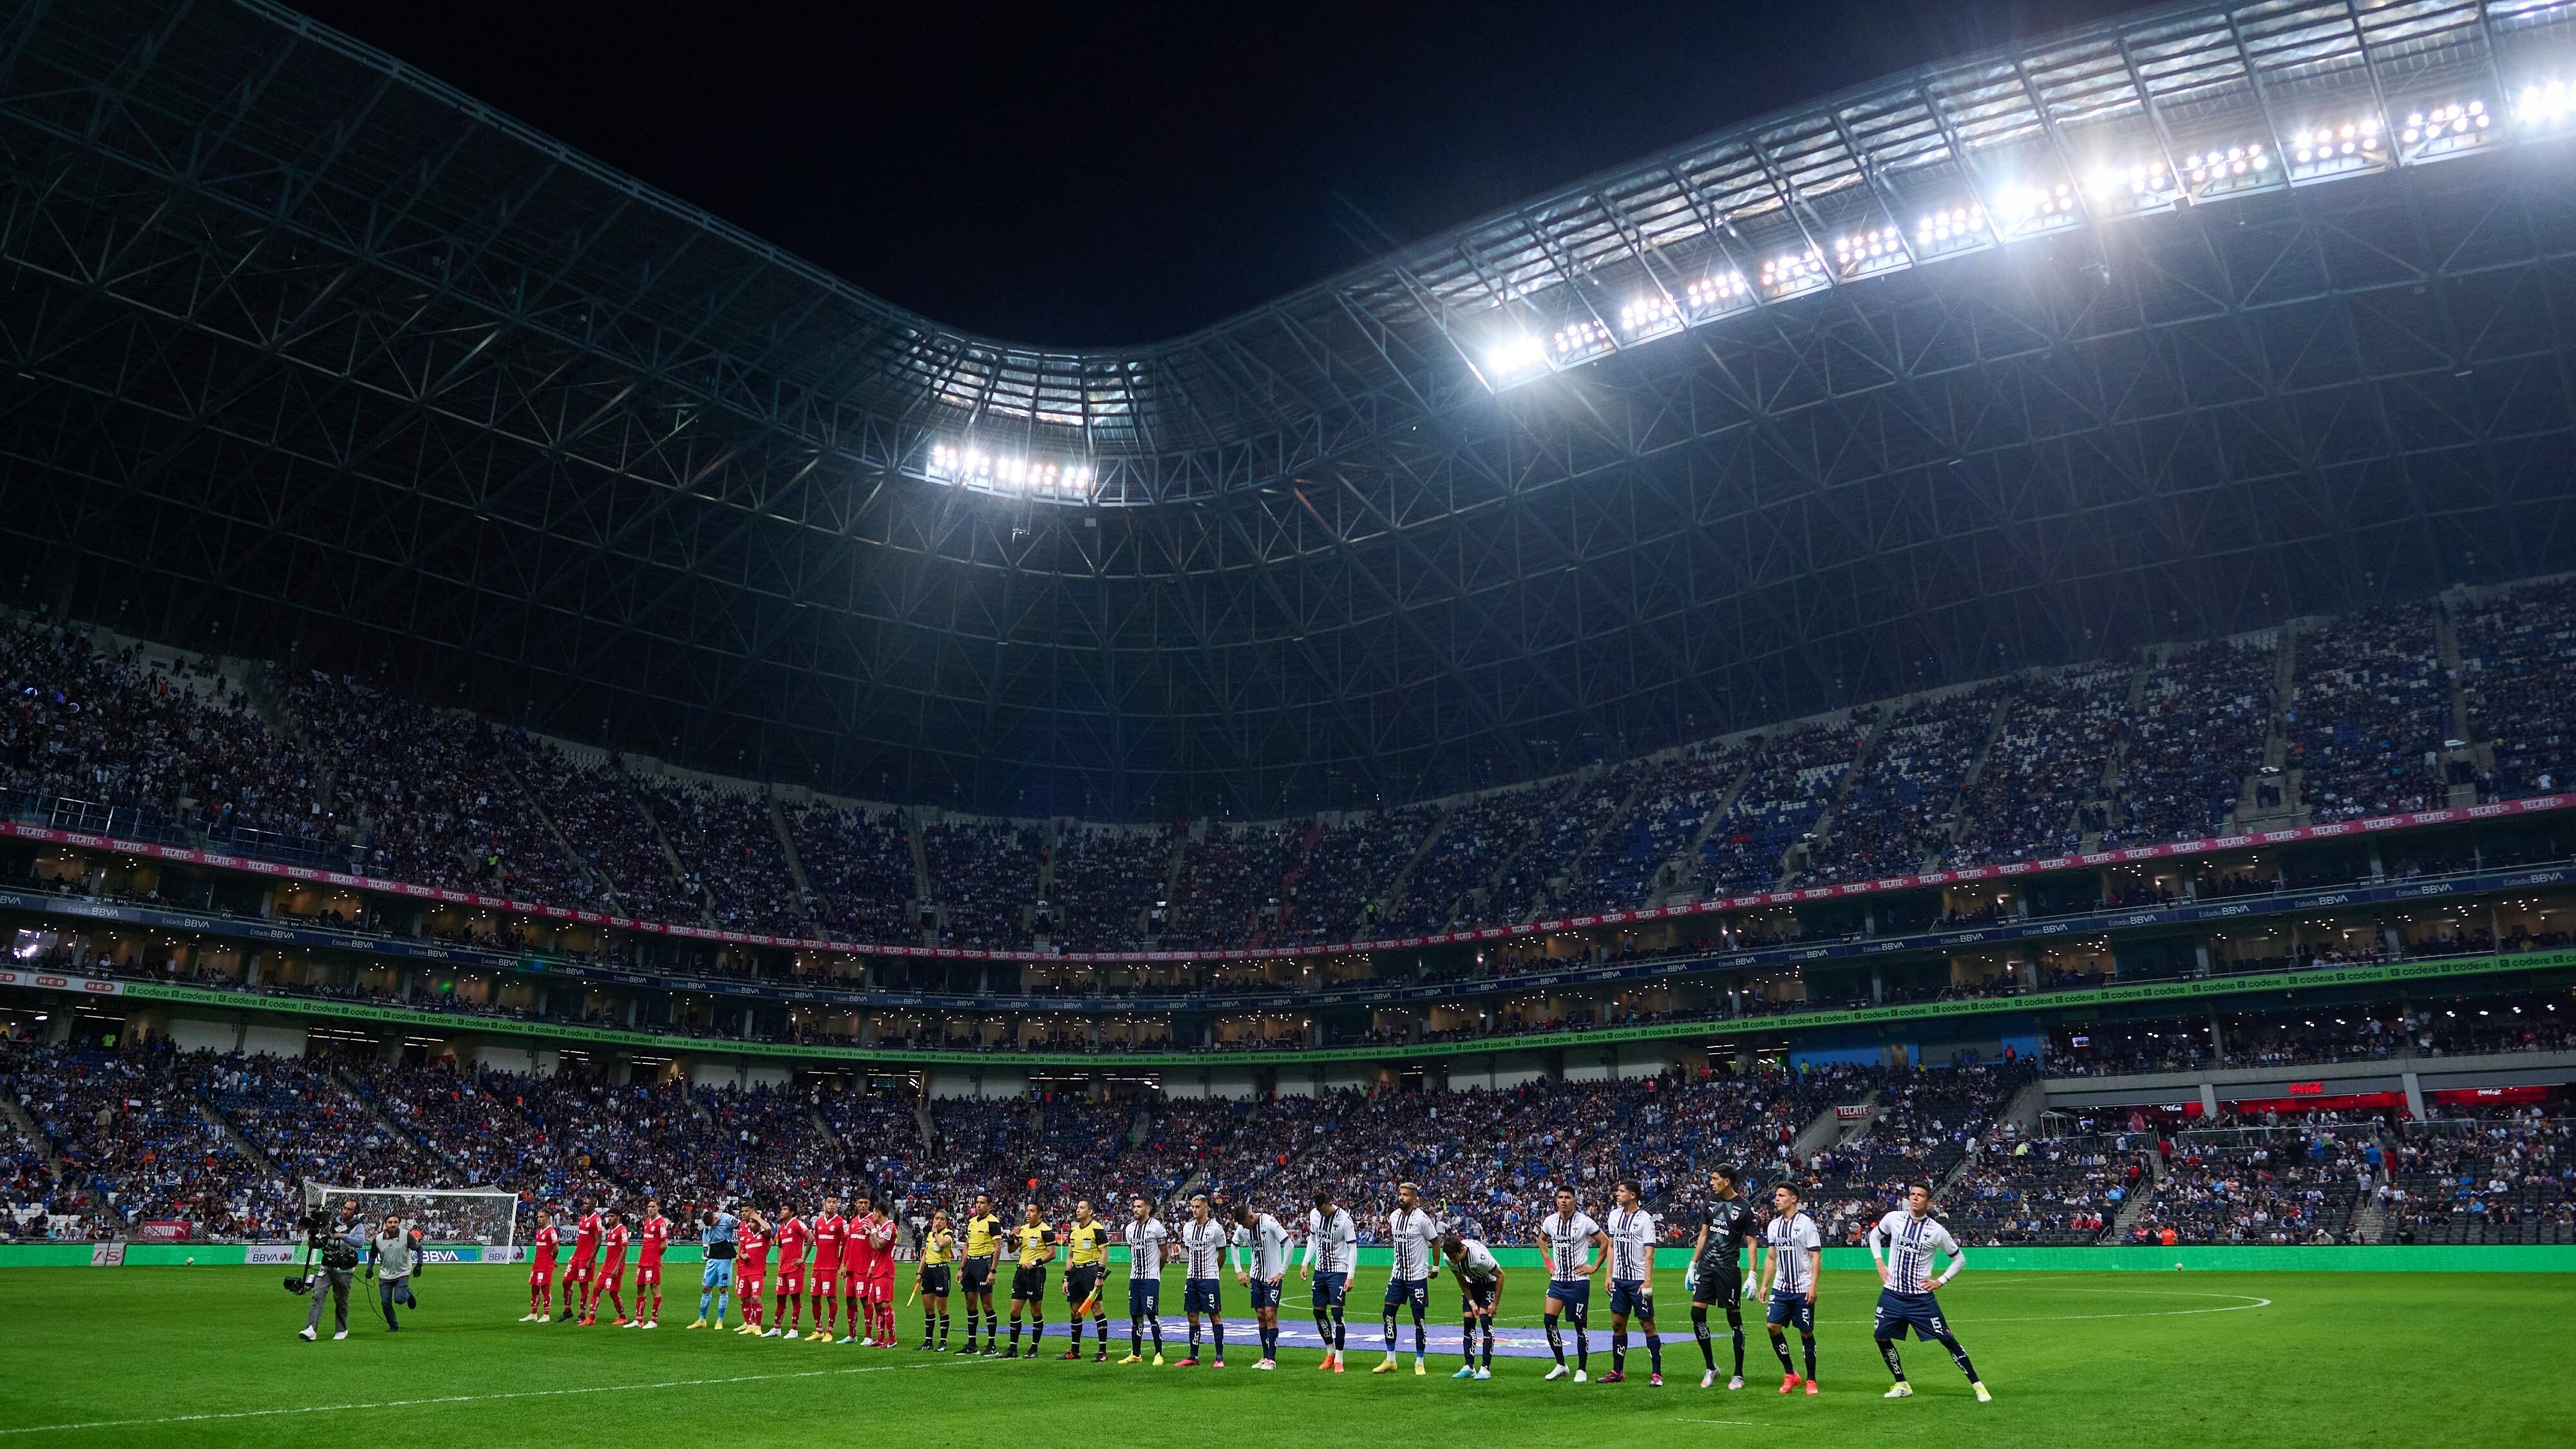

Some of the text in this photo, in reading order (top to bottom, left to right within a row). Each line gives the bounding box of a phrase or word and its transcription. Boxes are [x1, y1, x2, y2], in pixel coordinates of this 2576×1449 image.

[2521, 797, 2555, 810] TECATE
[2467, 804, 2501, 817] TECATE
[2363, 817, 2394, 829] TECATE
[16, 826, 46, 838] TECATE
[2264, 829, 2295, 842] TECATE
[67, 833, 97, 846] TECATE
[113, 840, 141, 852] TECATE
[2171, 841, 2199, 853] TECATE
[160, 847, 189, 860] TECATE
[2083, 853, 2109, 864] TECATE
[204, 853, 230, 866] TECATE
[288, 866, 313, 878] TECATE
[1999, 864, 2023, 875] TECATE
[1918, 873, 1942, 884] TECATE
[2504, 873, 2563, 886] Estadio BBVA
[367, 878, 391, 890] TECATE
[1843, 883, 1866, 893] TECATE
[2396, 884, 2452, 897] Estadio BBVA
[442, 891, 464, 901] TECATE
[1770, 892, 1792, 902] TECATE
[68, 904, 118, 918] Estadio BBVA
[546, 907, 567, 917] TECATE
[1667, 905, 1687, 915] TECATE
[2199, 905, 2249, 918] Estadio BBVA
[162, 916, 209, 929] Estadio BBVA
[611, 916, 629, 926] TECATE
[2108, 914, 2156, 927] Estadio BBVA
[251, 927, 294, 940] Estadio BBVA
[1482, 929, 1499, 937] TECATE
[2022, 923, 2067, 936] Estadio BBVA
[332, 938, 374, 950] Estadio BBVA
[776, 938, 796, 946] TECATE
[1941, 933, 1984, 945] Estadio BBVA
[1863, 941, 1904, 952] Estadio BBVA
[410, 947, 448, 959] Estadio BBVA
[2513, 957, 2550, 967] codere
[566, 967, 584, 976] BBVA
[1602, 971, 1621, 980] BBVA
[2347, 971, 2382, 980] codere
[2402, 967, 2438, 976] codere
[2202, 983, 2235, 992] codere
[2248, 979, 2281, 988] codere
[138, 988, 168, 998] codere
[182, 992, 211, 1001] codere
[2110, 990, 2141, 999] codere
[227, 997, 258, 1005] codere
[269, 1001, 297, 1009] codere
[1979, 1001, 2009, 1010] codere
[1823, 1014, 1848, 1023] codere
[1709, 1226, 1730, 1236] codere
[1900, 1236, 1919, 1245] BBVA
[1897, 1244, 1920, 1254] codere
[252, 1253, 278, 1262] BBVA
[1270, 1289, 1279, 1298] 27
[1338, 1286, 1343, 1296] 7
[1414, 1288, 1425, 1298] 29
[1486, 1291, 1495, 1301] 33
[1146, 1296, 1154, 1305] 16
[1208, 1293, 1215, 1303] 9
[1577, 1302, 1584, 1312] 17
[1930, 1317, 1942, 1329] 15
